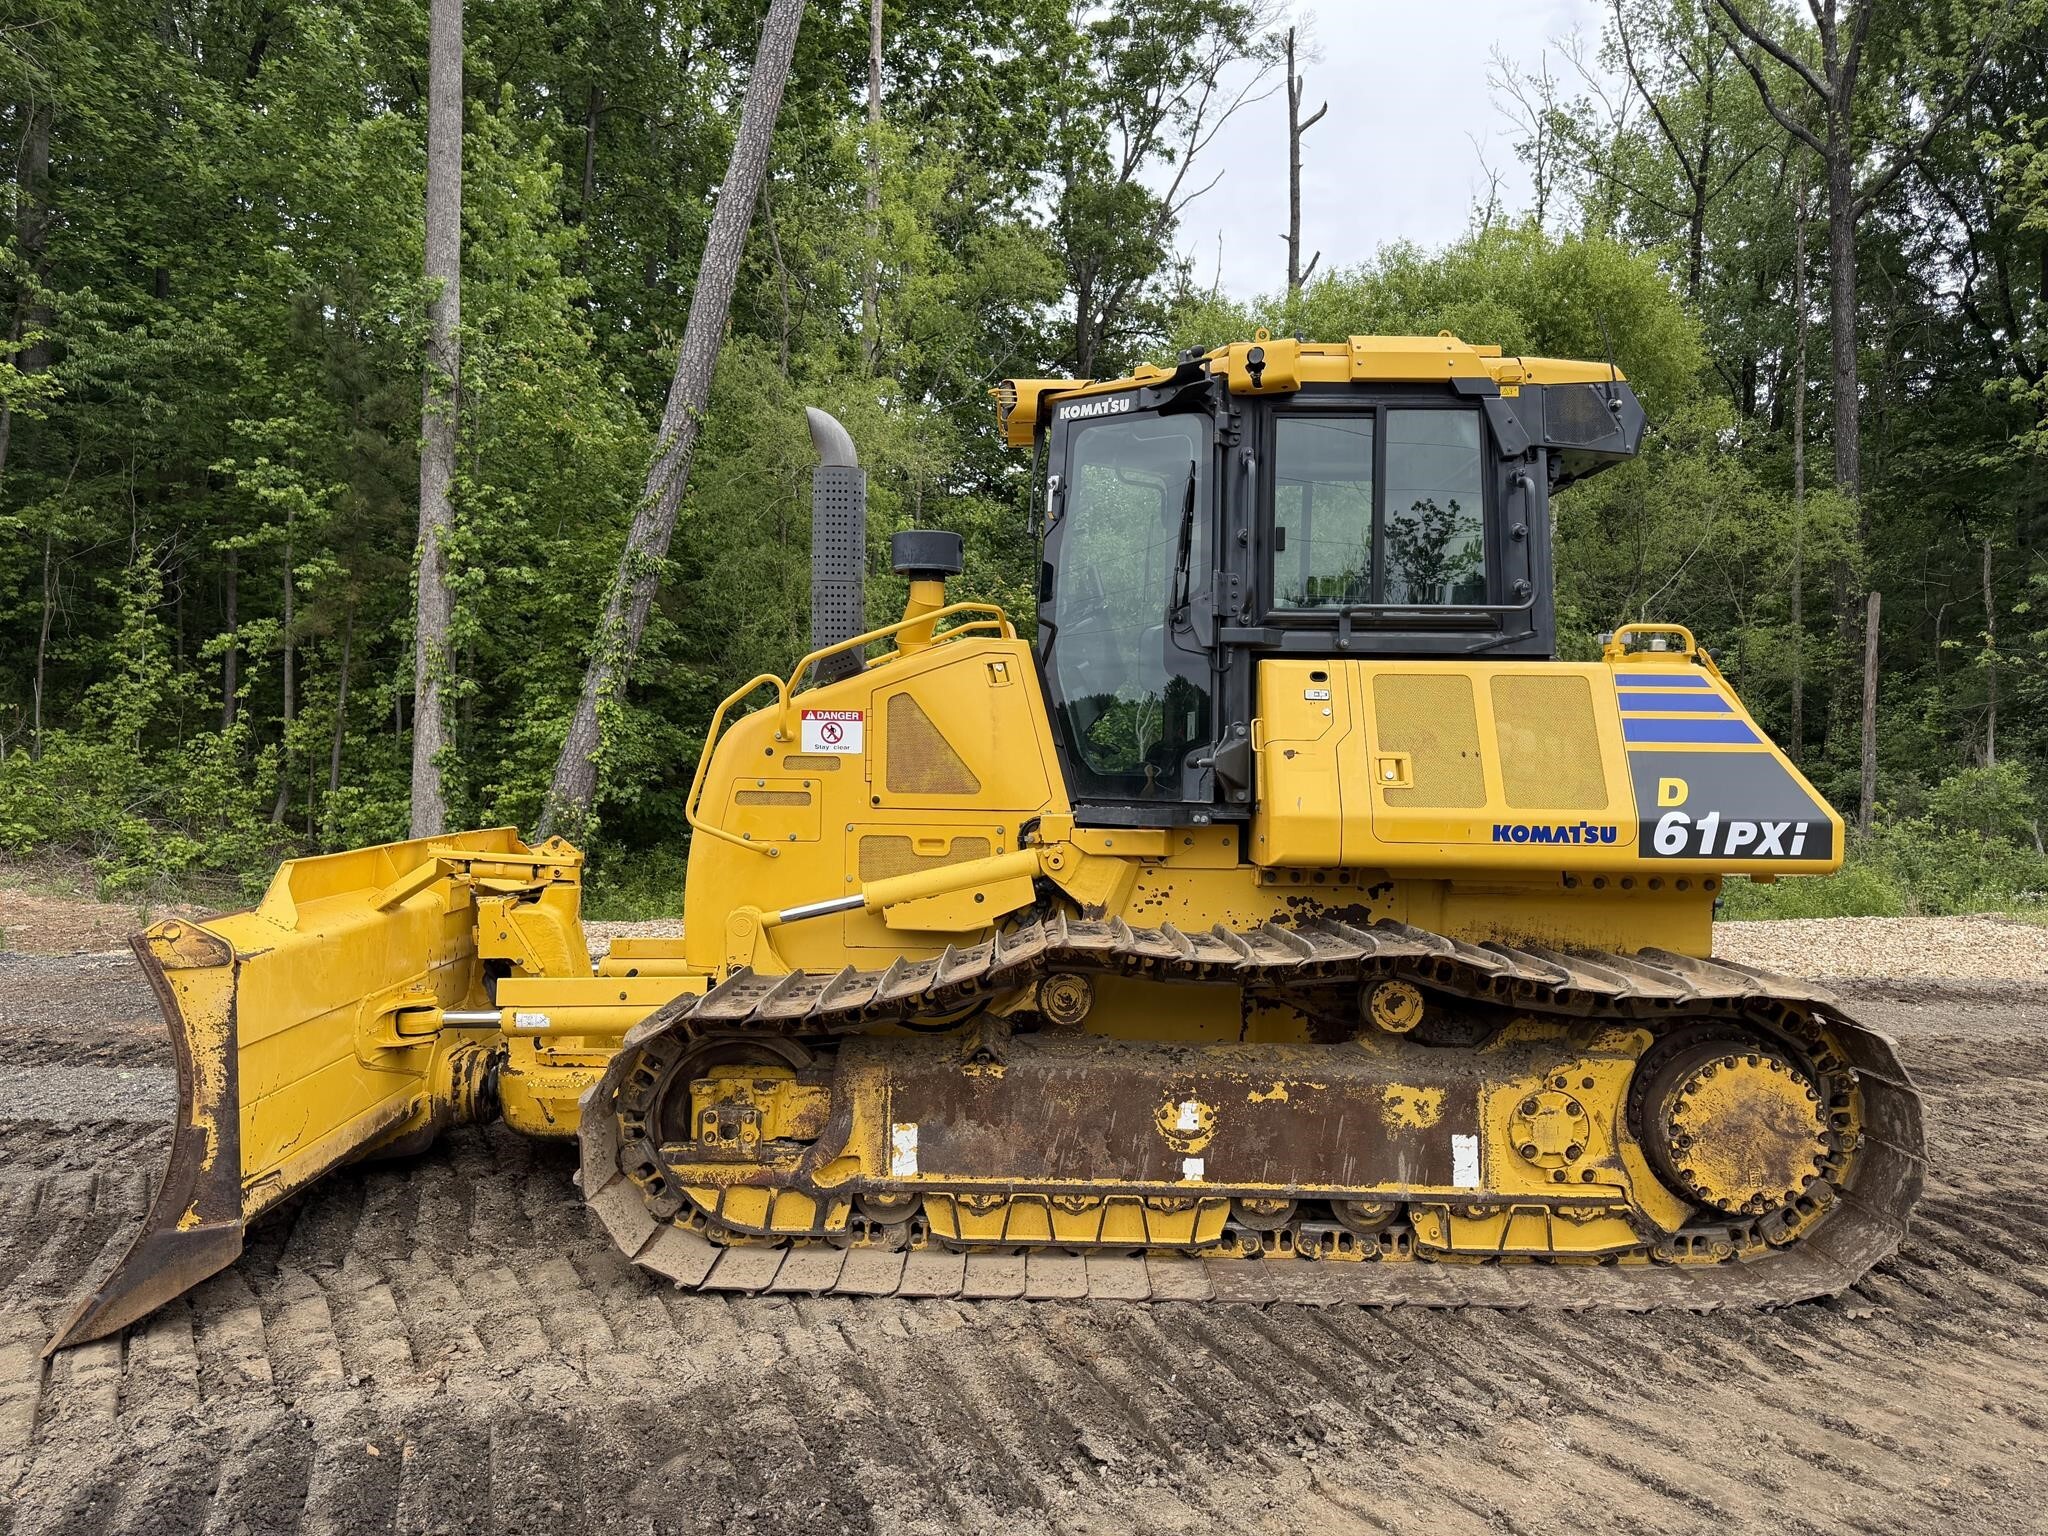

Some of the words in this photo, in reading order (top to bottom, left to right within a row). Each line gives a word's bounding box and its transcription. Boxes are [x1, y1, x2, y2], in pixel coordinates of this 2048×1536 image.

[1060, 397, 1130, 419] KOMATSU
[816, 711, 859, 720] DANGER
[814, 743, 830, 751] Stay
[1657, 777, 1689, 807] D
[1492, 821, 1617, 844] KOMATSU
[1653, 811, 1809, 856] 61PXi
